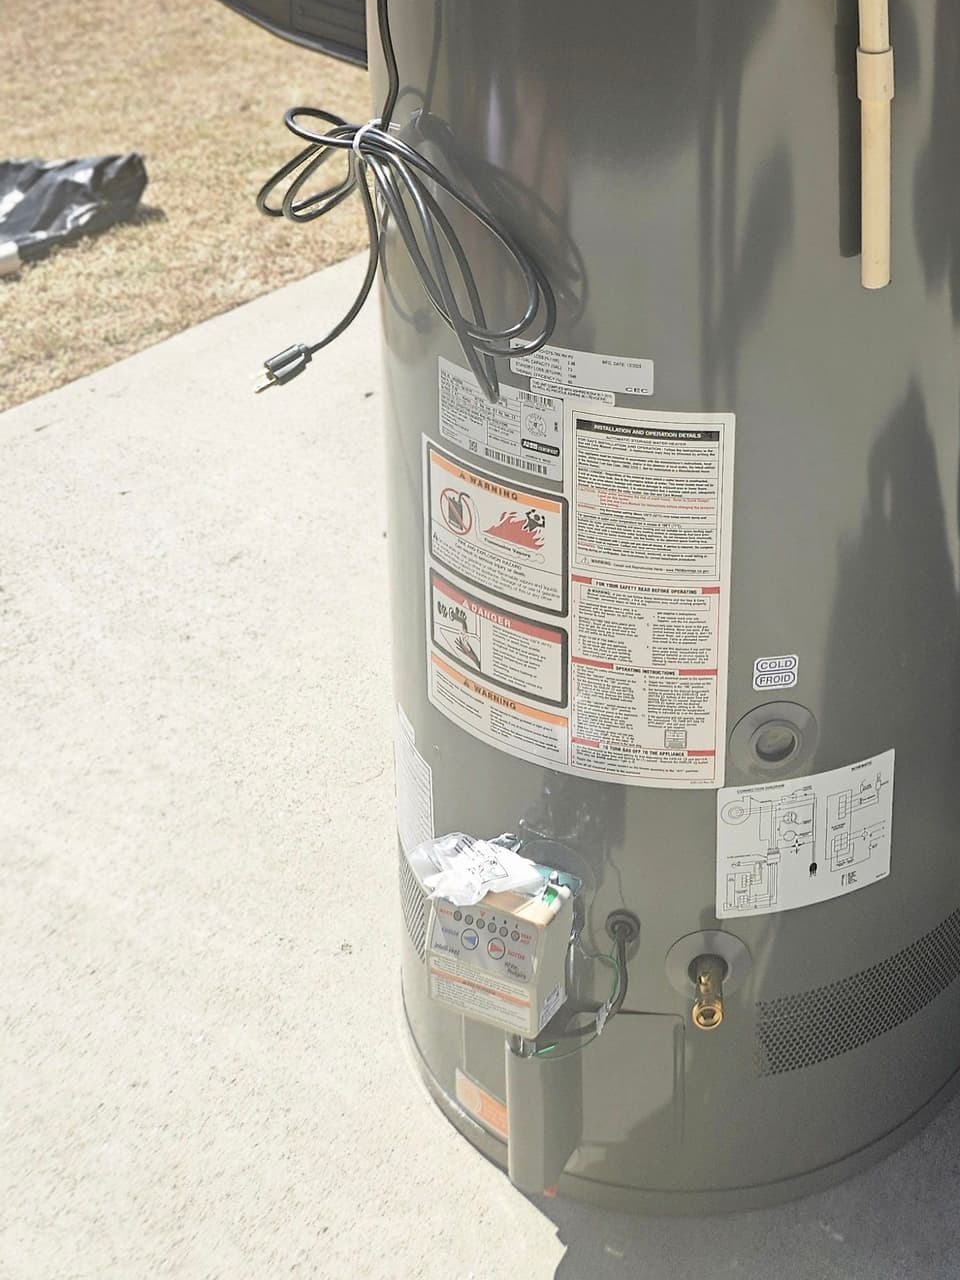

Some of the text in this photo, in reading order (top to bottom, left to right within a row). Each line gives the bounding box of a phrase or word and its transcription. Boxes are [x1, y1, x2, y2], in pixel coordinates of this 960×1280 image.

[625, 386, 649, 394] CEC
[470, 477, 519, 501] WARNING
[619, 583, 637, 591] SAFETY
[471, 603, 512, 628] DANGER
[761, 660, 793, 669] COLD
[760, 674, 791, 684] FROID
[474, 685, 517, 710] WARNING
